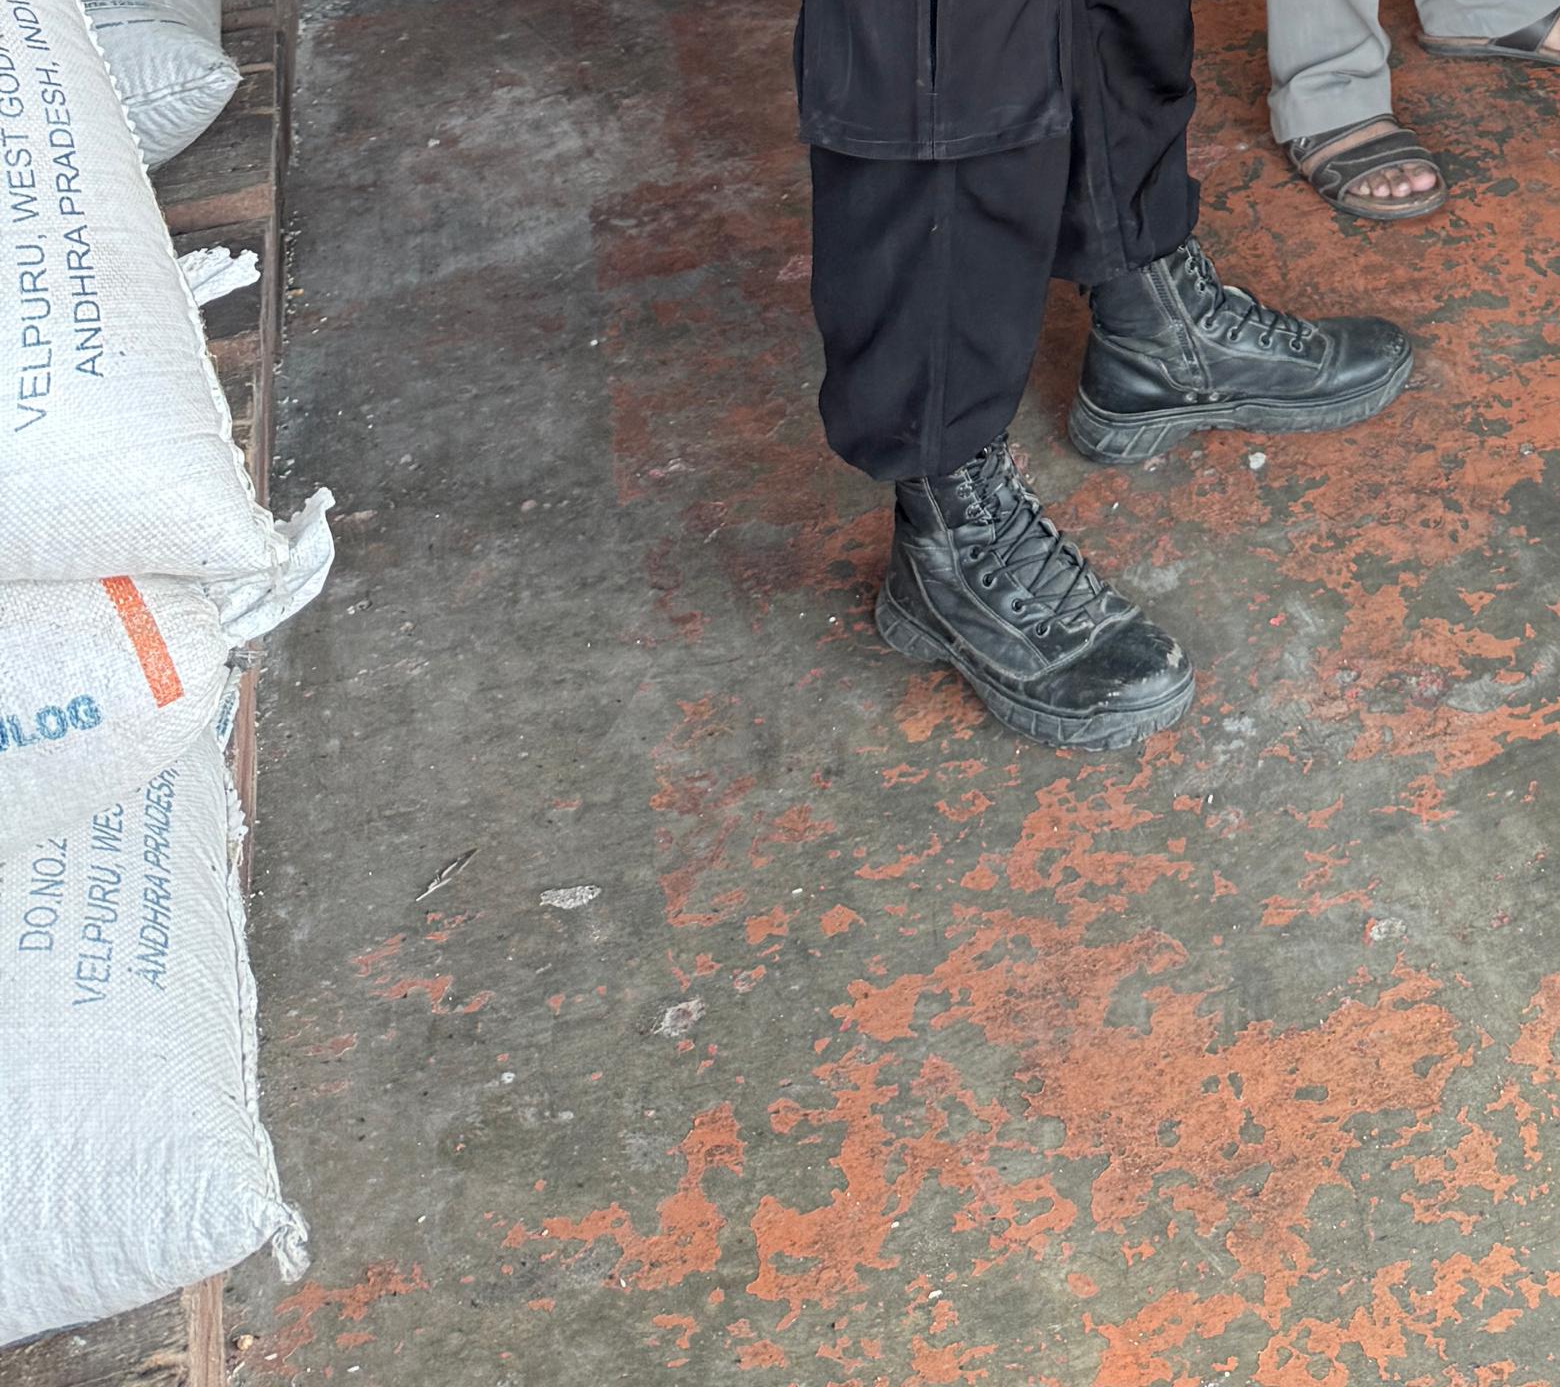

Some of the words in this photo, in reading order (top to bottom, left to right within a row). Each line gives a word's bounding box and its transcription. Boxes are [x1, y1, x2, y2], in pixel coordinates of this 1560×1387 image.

[4, 105, 38, 225] WEST
[41, 51, 89, 219] PRADESH,
[16, 231, 54, 433] VELPURU,
[59, 223, 104, 379] ANDHRA
[72, 860, 127, 1009] VELPURU,
[129, 871, 177, 992] ANDHRA
